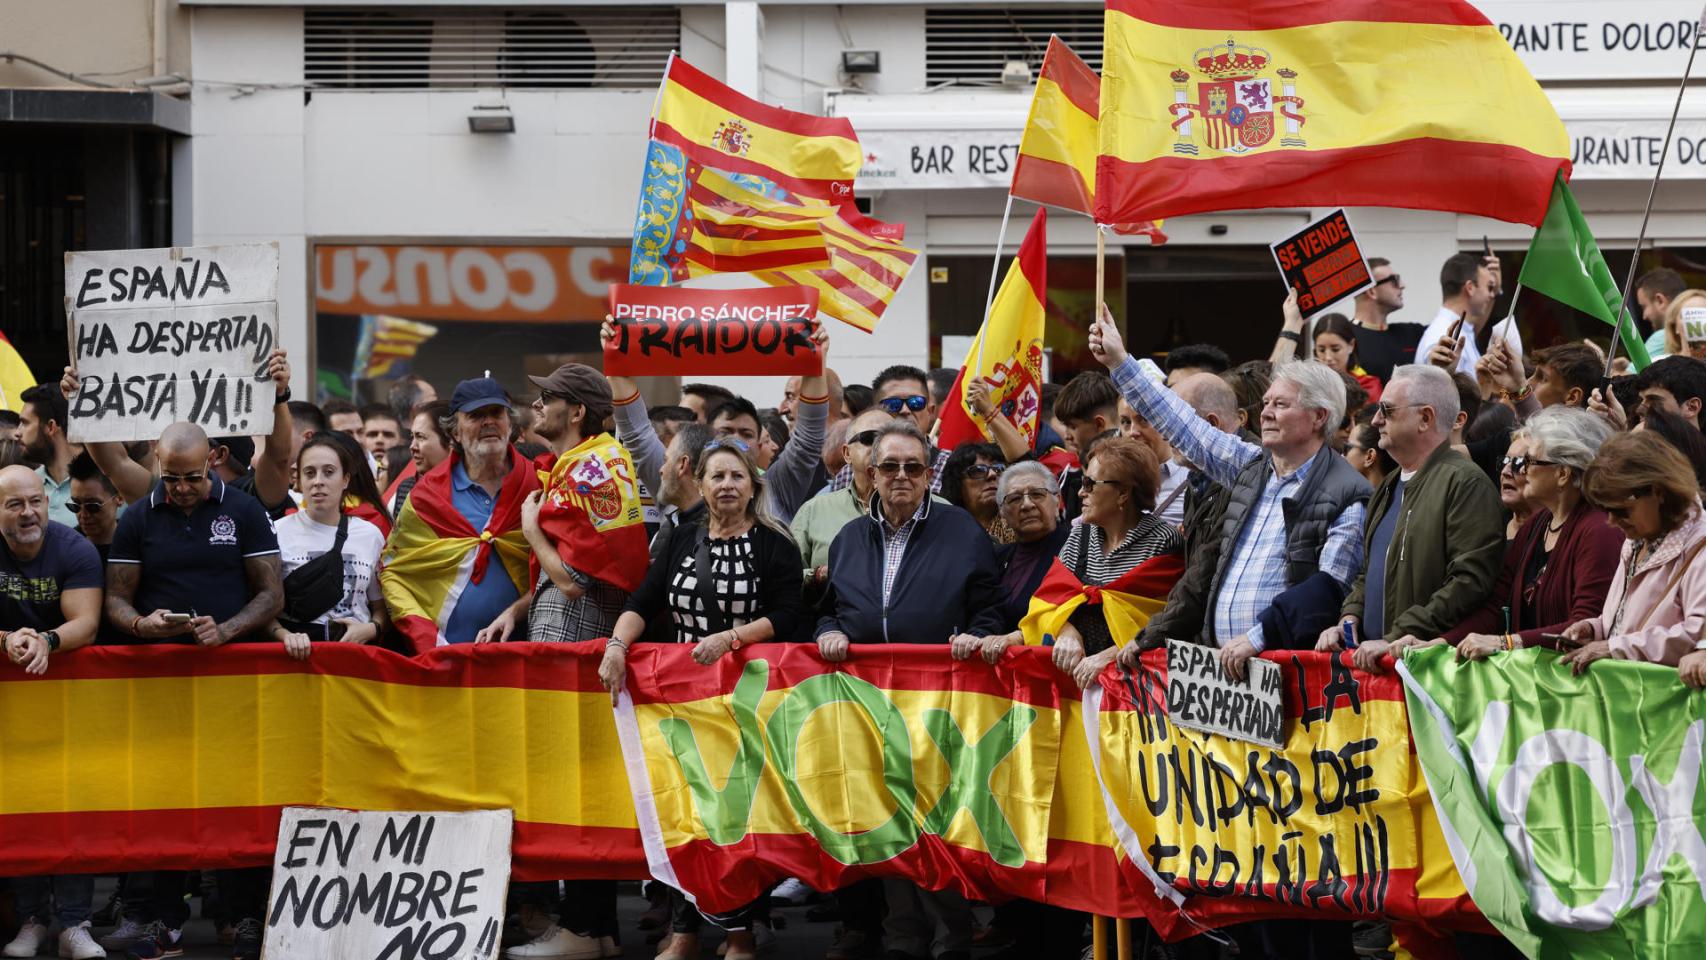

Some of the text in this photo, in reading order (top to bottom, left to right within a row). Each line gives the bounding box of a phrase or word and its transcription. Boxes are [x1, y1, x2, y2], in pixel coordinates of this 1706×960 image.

[911, 145, 954, 174] BAR
[1278, 215, 1350, 271] SE VENDE
[76, 257, 231, 309] ESPAÑA
[613, 316, 817, 358] TRAIDOR
[616, 303, 811, 322] PEDRO SÁNCHEZ
[77, 322, 118, 360] HA
[70, 372, 177, 421] BASTA
[1260, 665, 1282, 697] HA
[1292, 652, 1361, 733] LA
[1167, 678, 1284, 745] DESPERTADO
[658, 659, 1038, 868] VOX
[1138, 738, 1380, 832] UNIDAD DE
[281, 814, 435, 869] EN MI
[269, 868, 484, 931] NOMBRE
